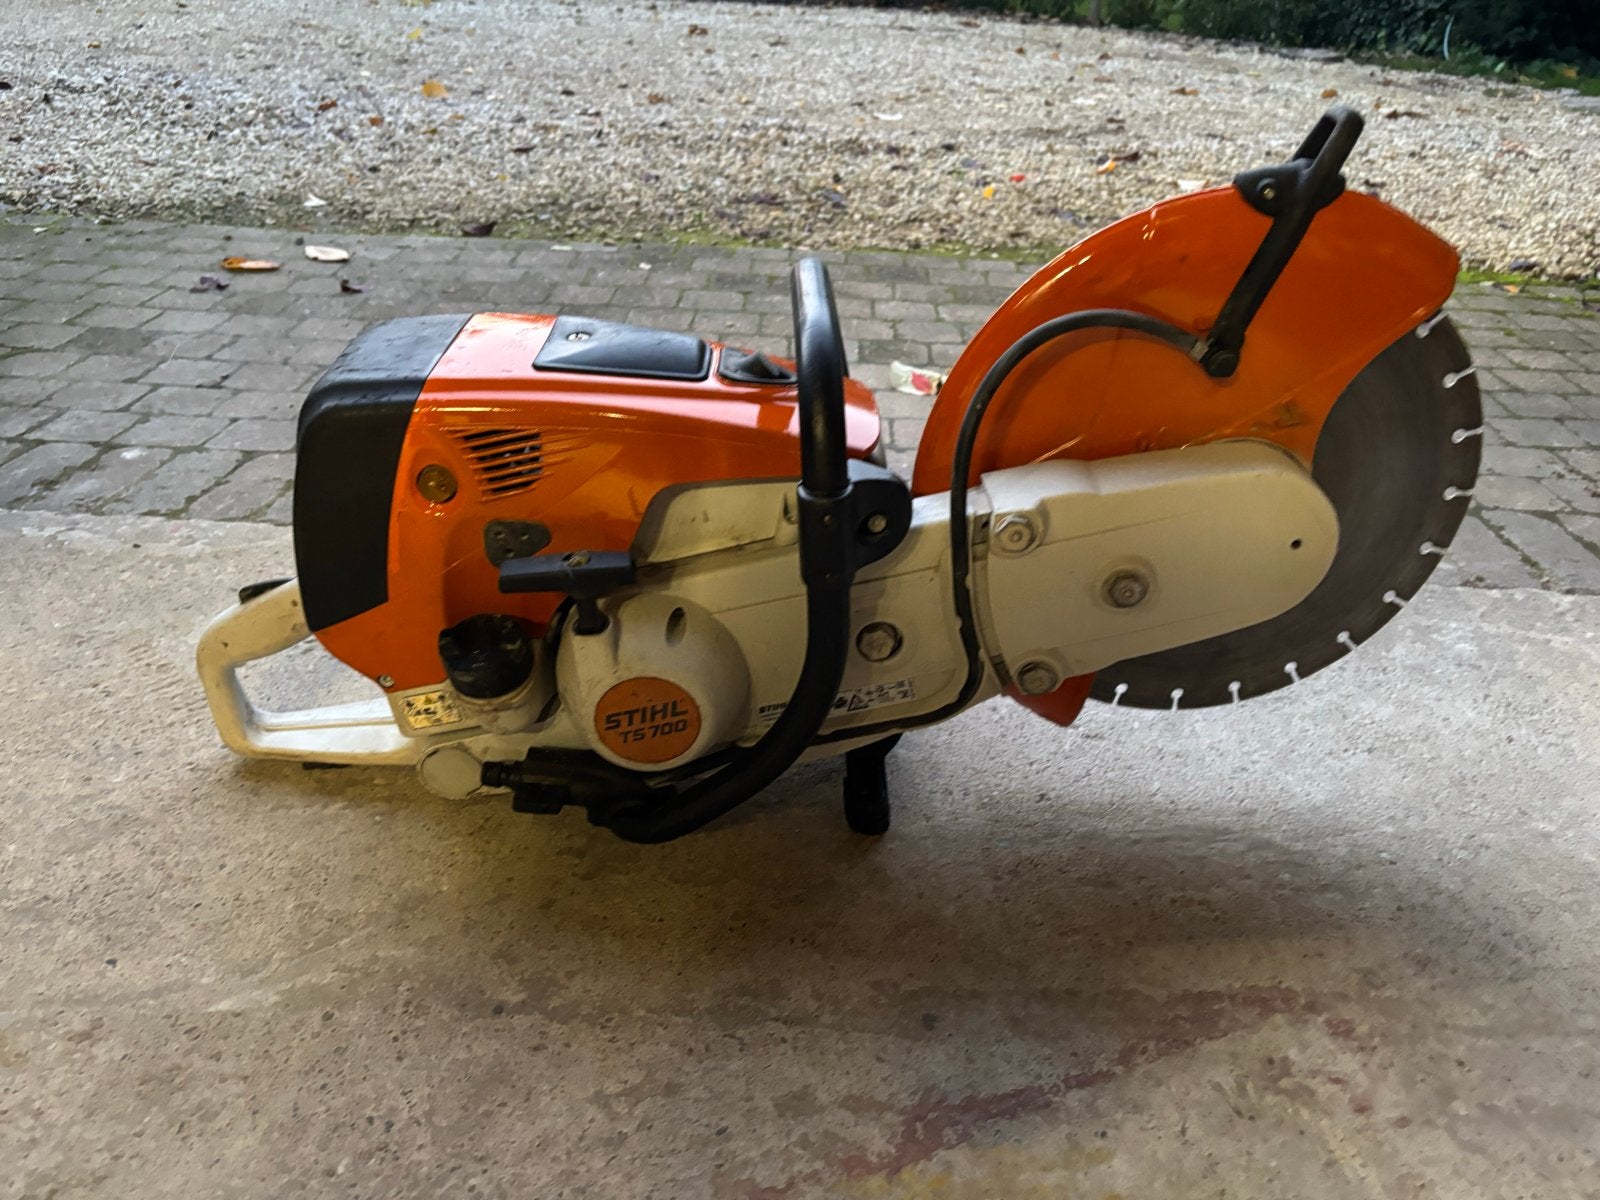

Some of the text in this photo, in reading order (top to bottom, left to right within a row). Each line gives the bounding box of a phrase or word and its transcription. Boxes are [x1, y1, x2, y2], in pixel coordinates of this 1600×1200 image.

[605, 700, 688, 731] STIHL
[619, 719, 688, 744] TS 700
